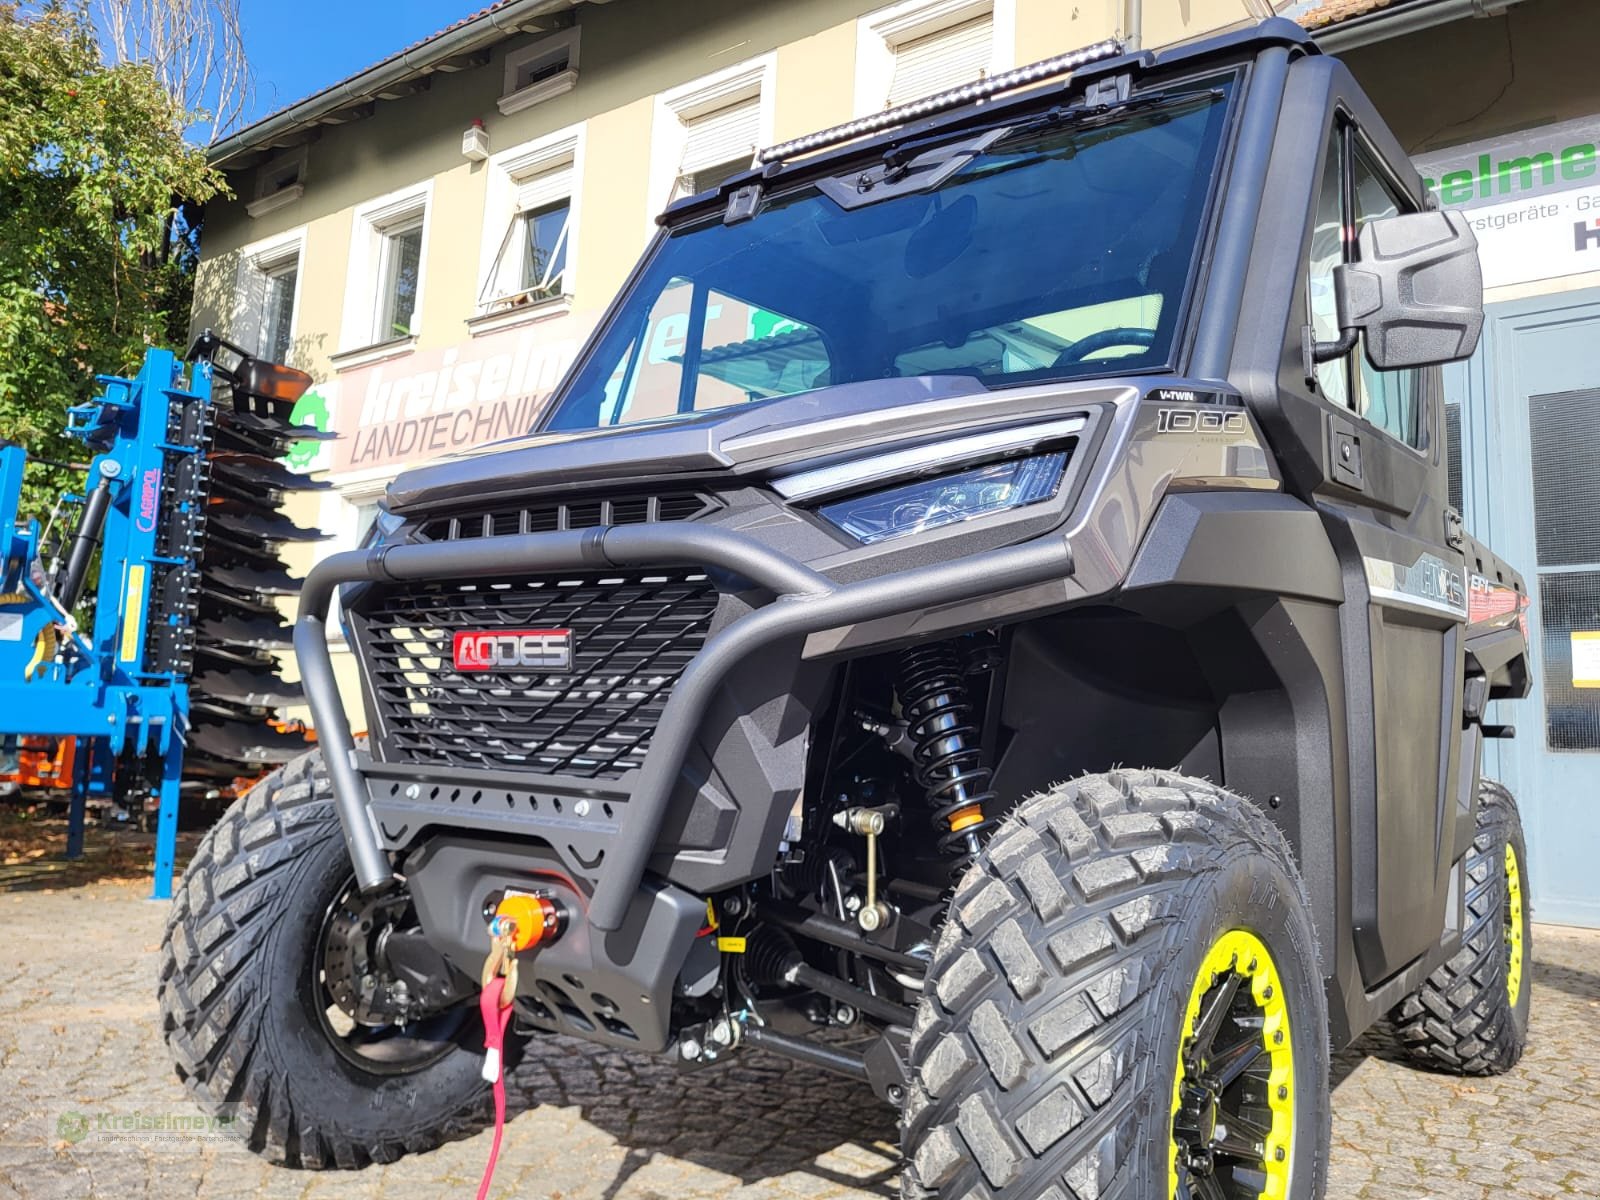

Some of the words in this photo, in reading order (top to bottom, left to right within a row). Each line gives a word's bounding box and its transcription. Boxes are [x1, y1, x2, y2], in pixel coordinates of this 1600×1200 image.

[1160, 390, 1194, 401] V-TWIN
[349, 391, 553, 465] LANDTECHNIK
[1157, 408, 1249, 434] 1000
[457, 635, 570, 666] AODES
